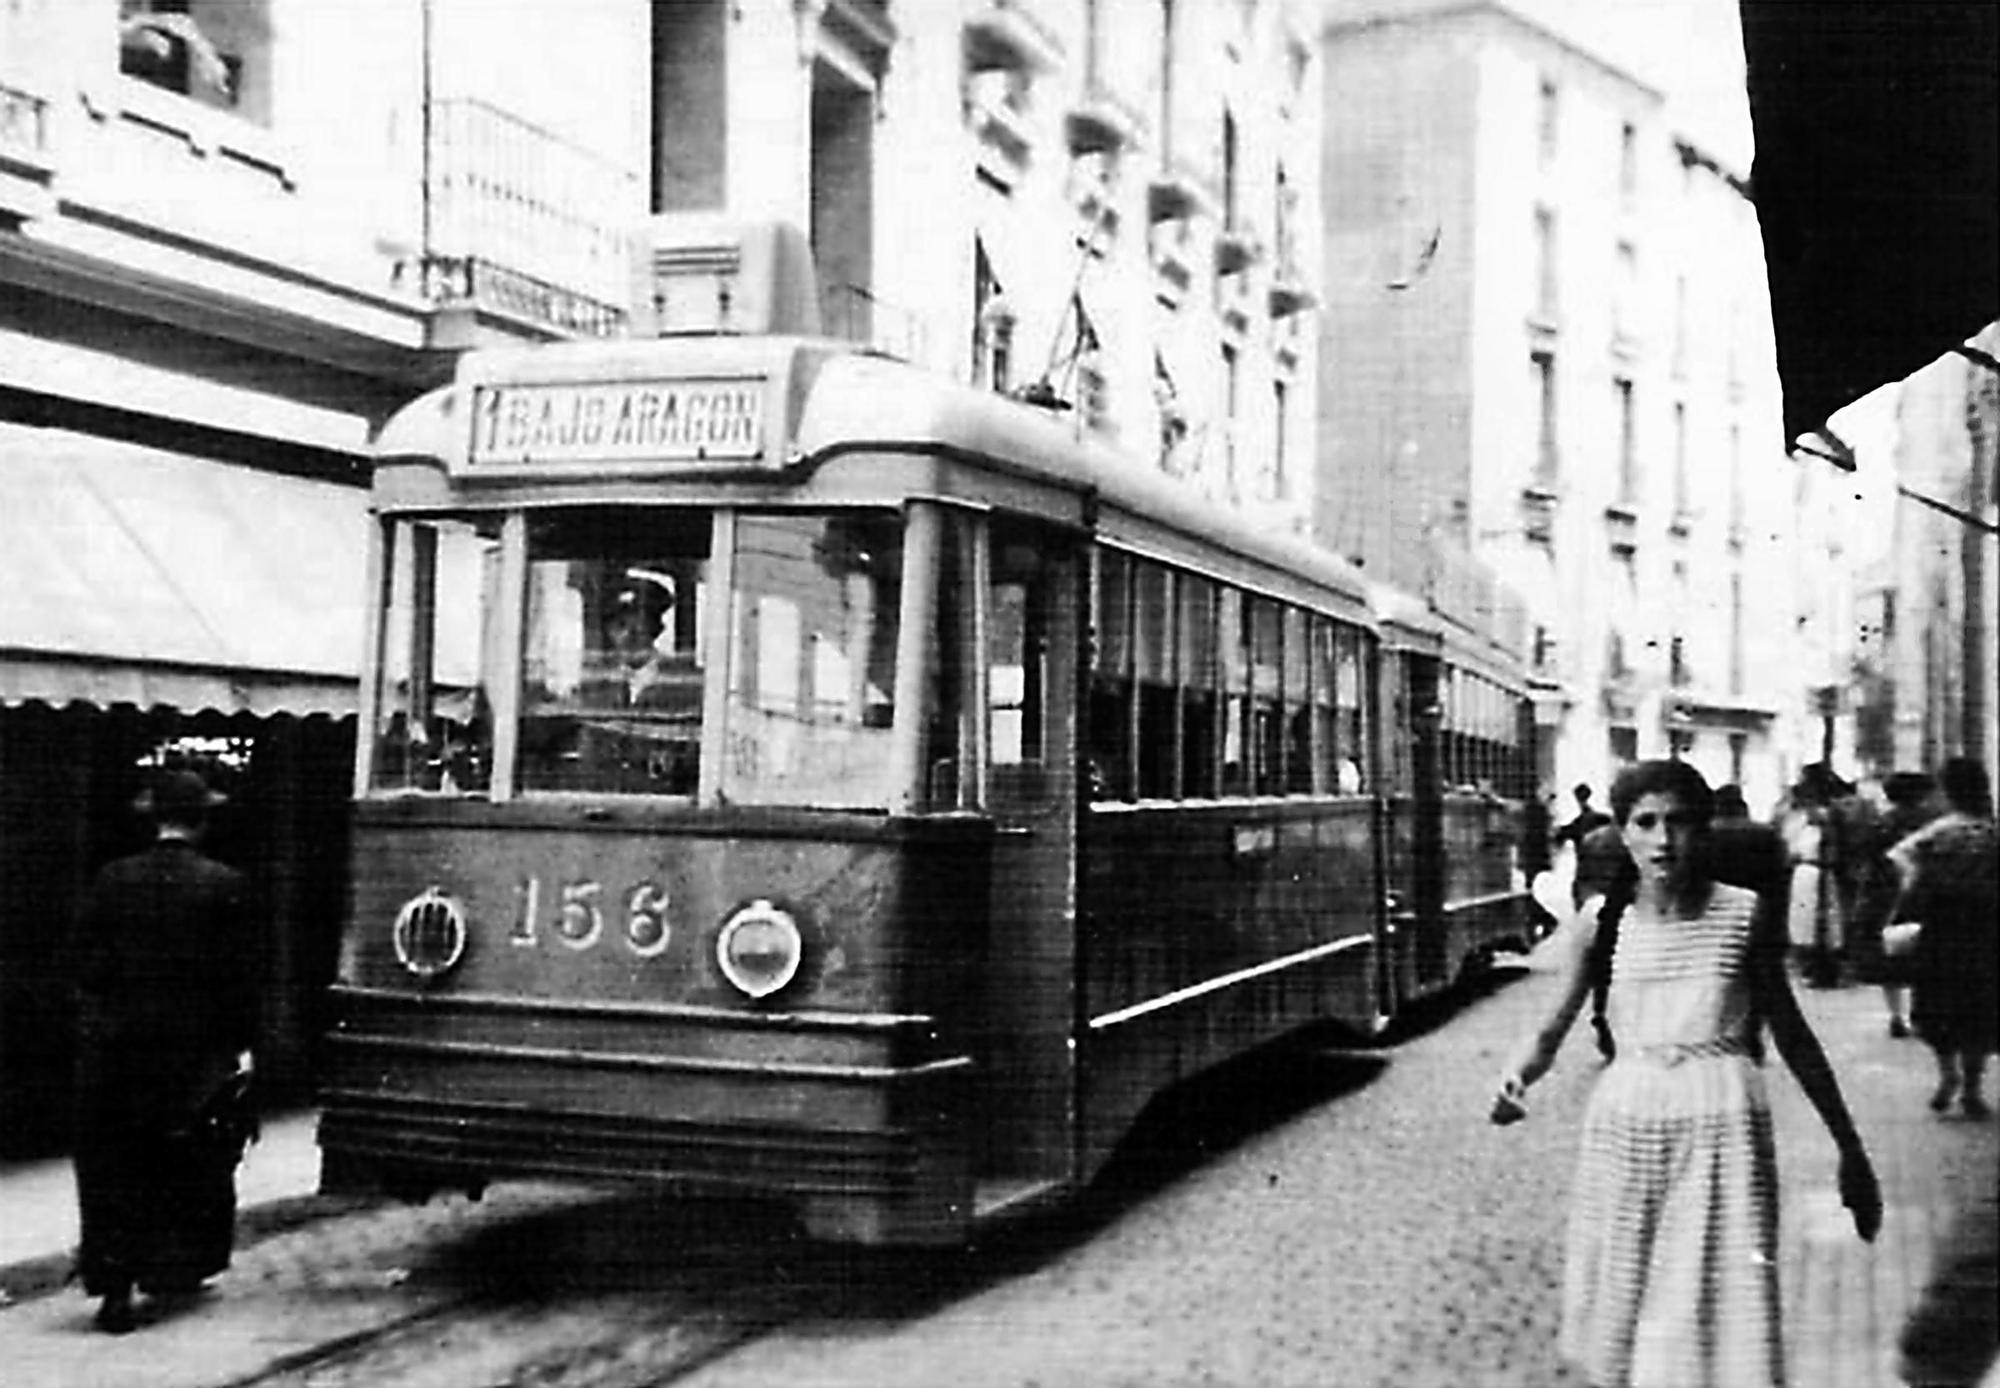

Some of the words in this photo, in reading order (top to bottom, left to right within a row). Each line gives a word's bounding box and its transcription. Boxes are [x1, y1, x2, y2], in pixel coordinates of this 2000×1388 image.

[486, 389, 501, 451] 1
[507, 396, 604, 446] BAJO
[612, 392, 760, 445] ARAGON
[509, 876, 671, 957] 156
